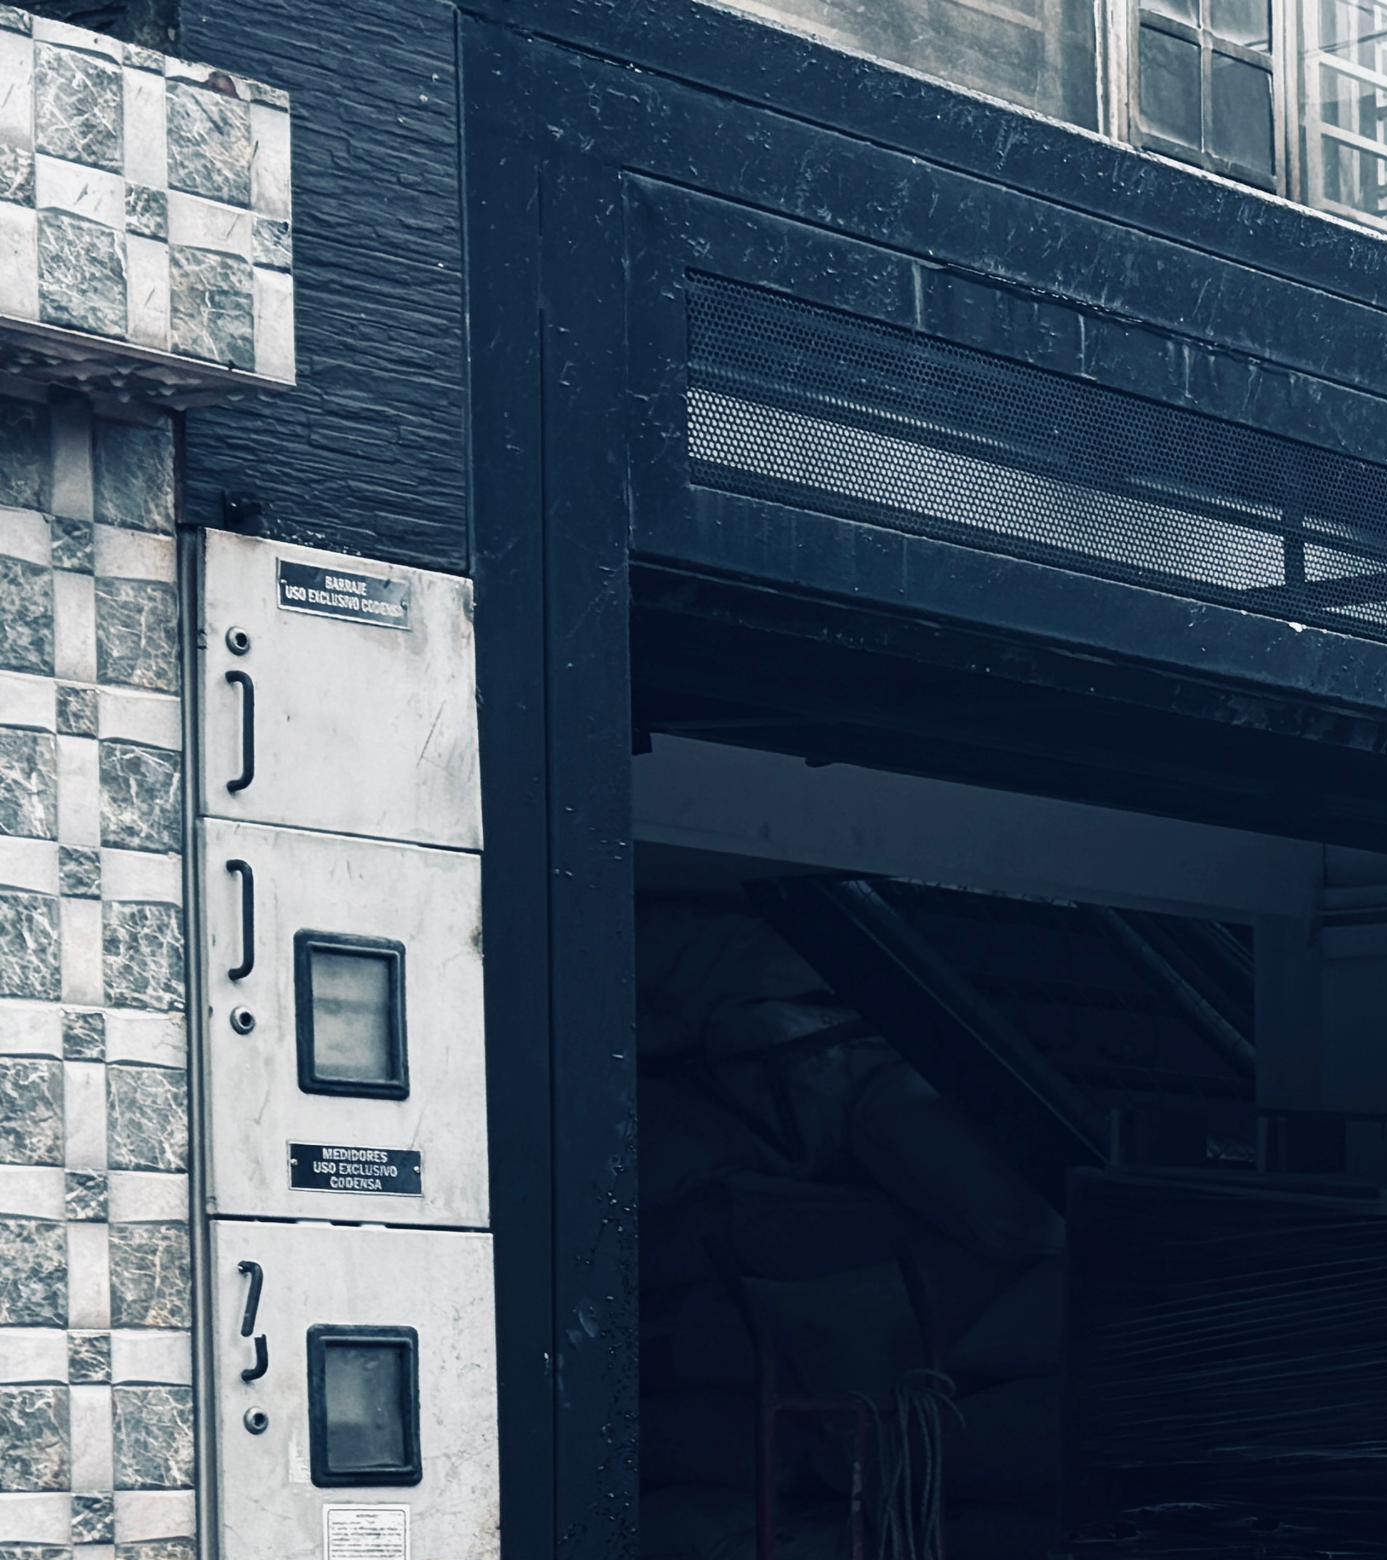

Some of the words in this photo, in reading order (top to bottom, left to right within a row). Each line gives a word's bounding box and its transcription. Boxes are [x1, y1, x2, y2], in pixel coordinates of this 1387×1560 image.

[285, 585, 307, 601] USO
[308, 588, 360, 611] EXCLUSIVO
[322, 1147, 388, 1163] MEDIDORES
[313, 1161, 337, 1174] USO
[339, 1163, 398, 1178] EXCLUSIVO
[330, 1176, 382, 1190] CODENSA
